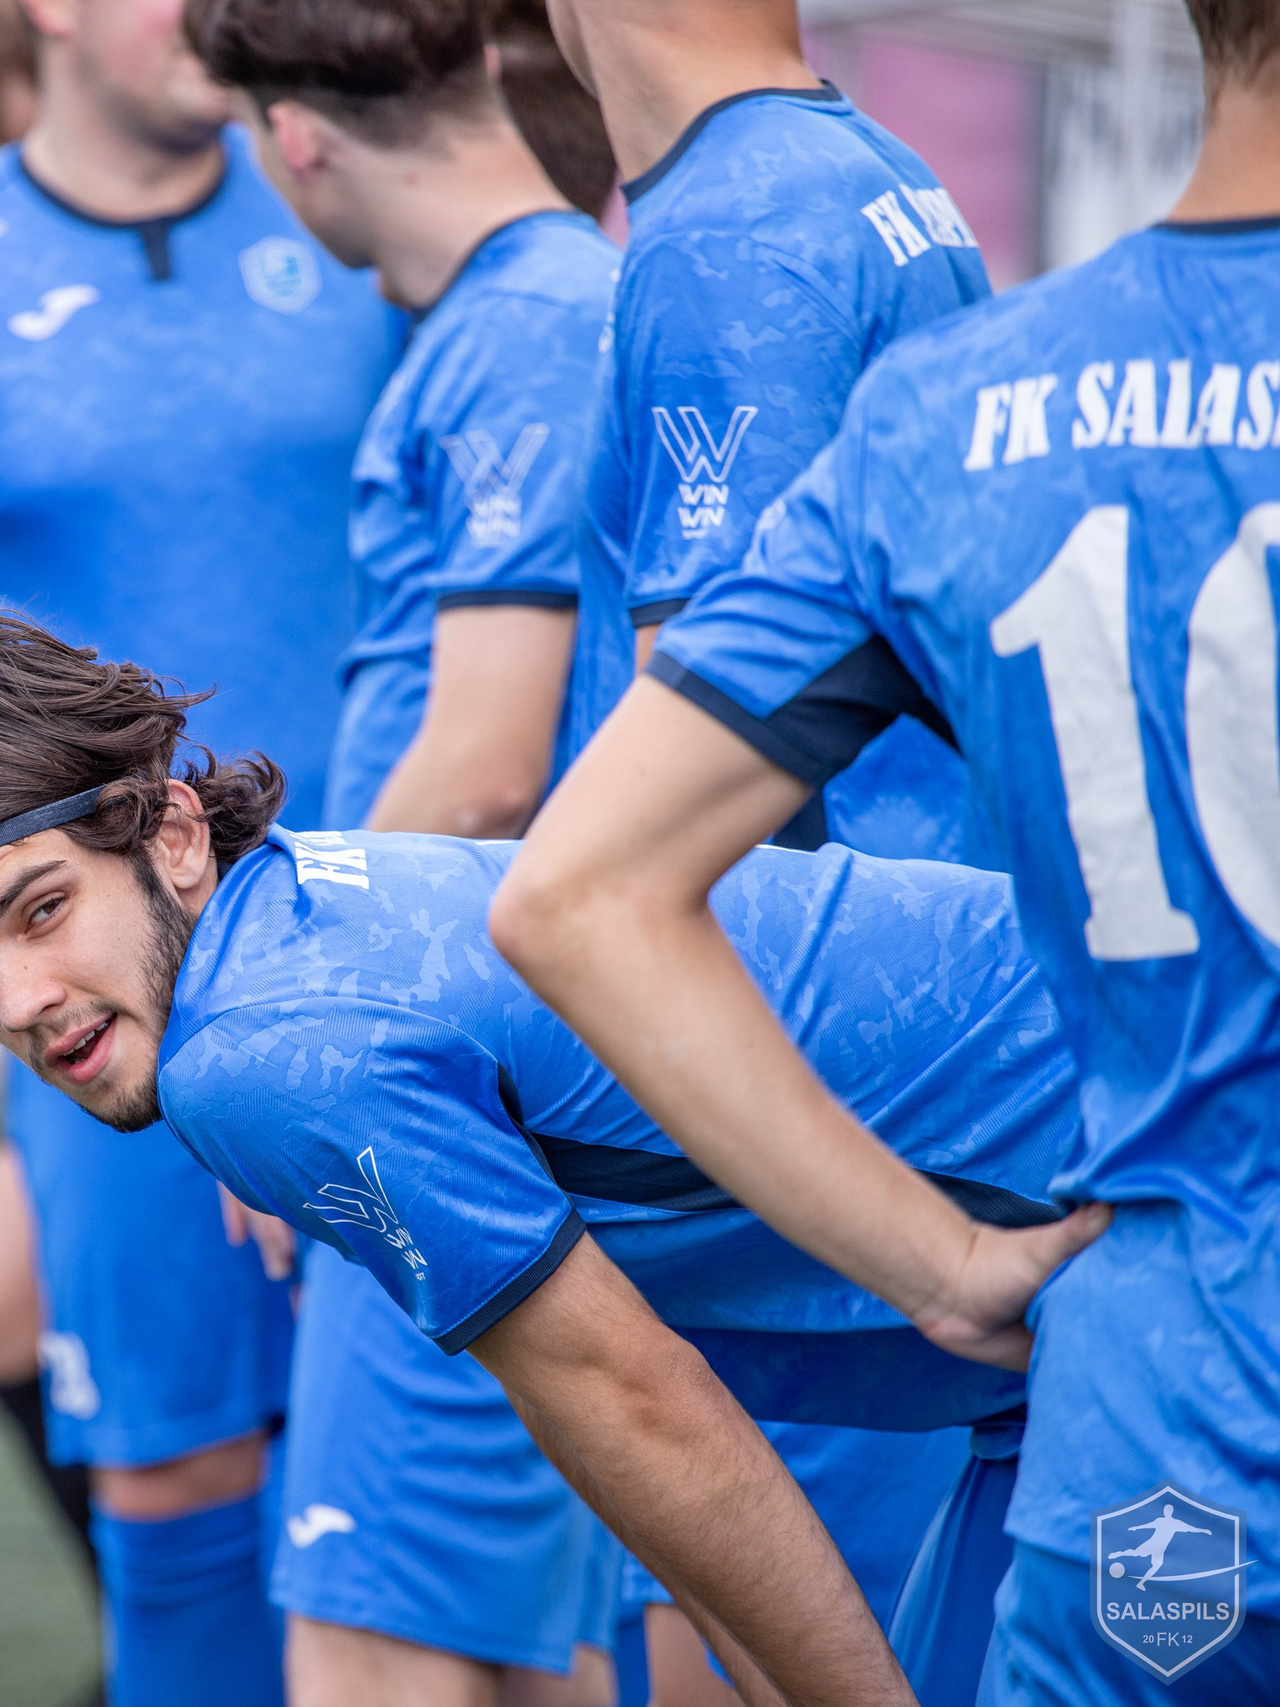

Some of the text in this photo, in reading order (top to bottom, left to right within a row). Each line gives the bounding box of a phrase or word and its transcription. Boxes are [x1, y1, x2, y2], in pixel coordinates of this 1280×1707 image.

[860, 190, 932, 267] FK
[963, 358, 1280, 471] FK SALAS
[293, 841, 370, 890] FK
